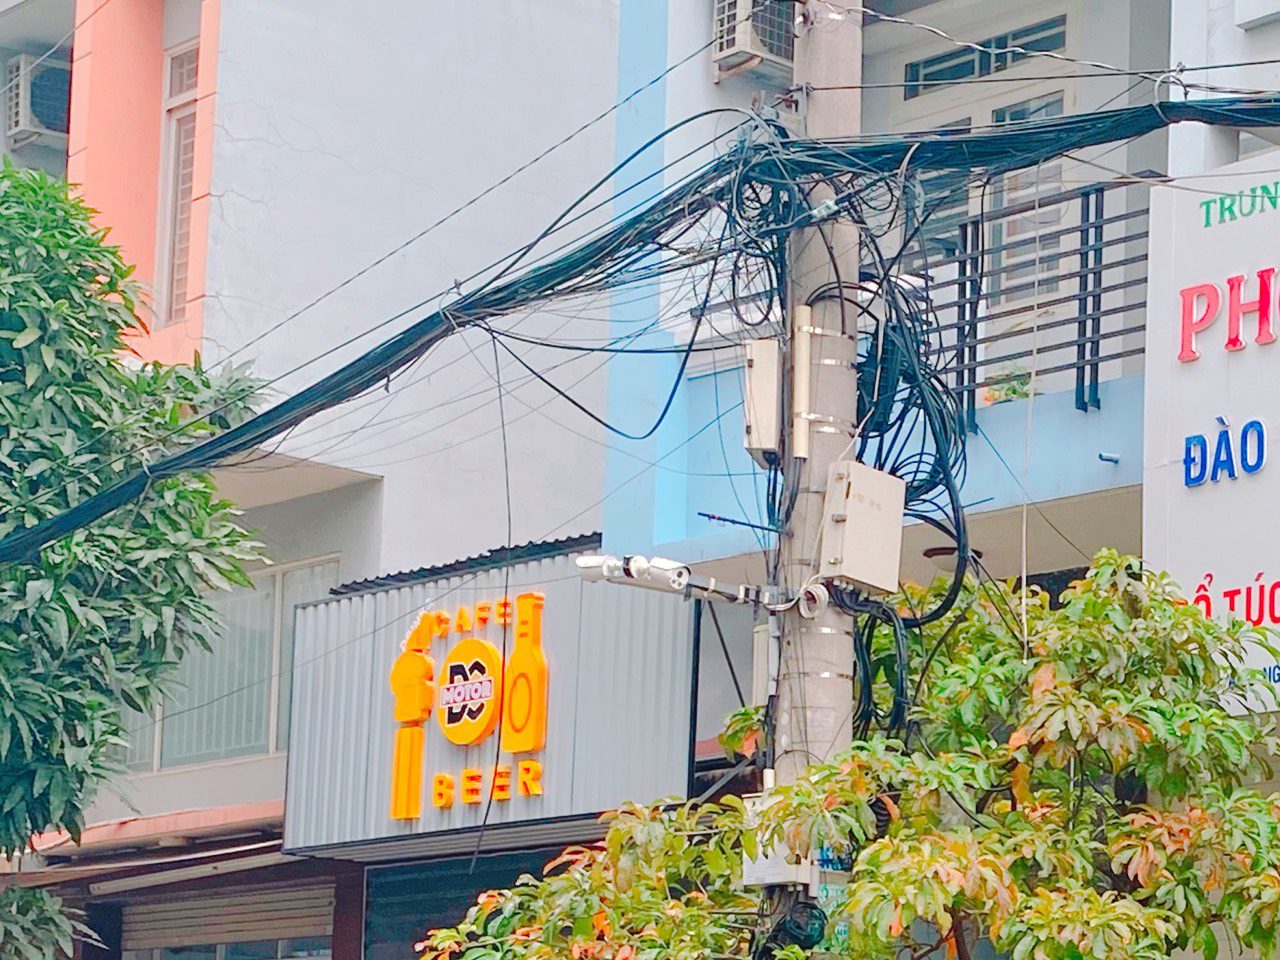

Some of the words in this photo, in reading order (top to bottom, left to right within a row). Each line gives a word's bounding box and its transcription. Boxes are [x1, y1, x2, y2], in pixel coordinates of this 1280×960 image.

[1181, 416, 1267, 488] ĐÀO
[441, 679, 494, 706] MOTOR
[433, 759, 544, 808] BEER
